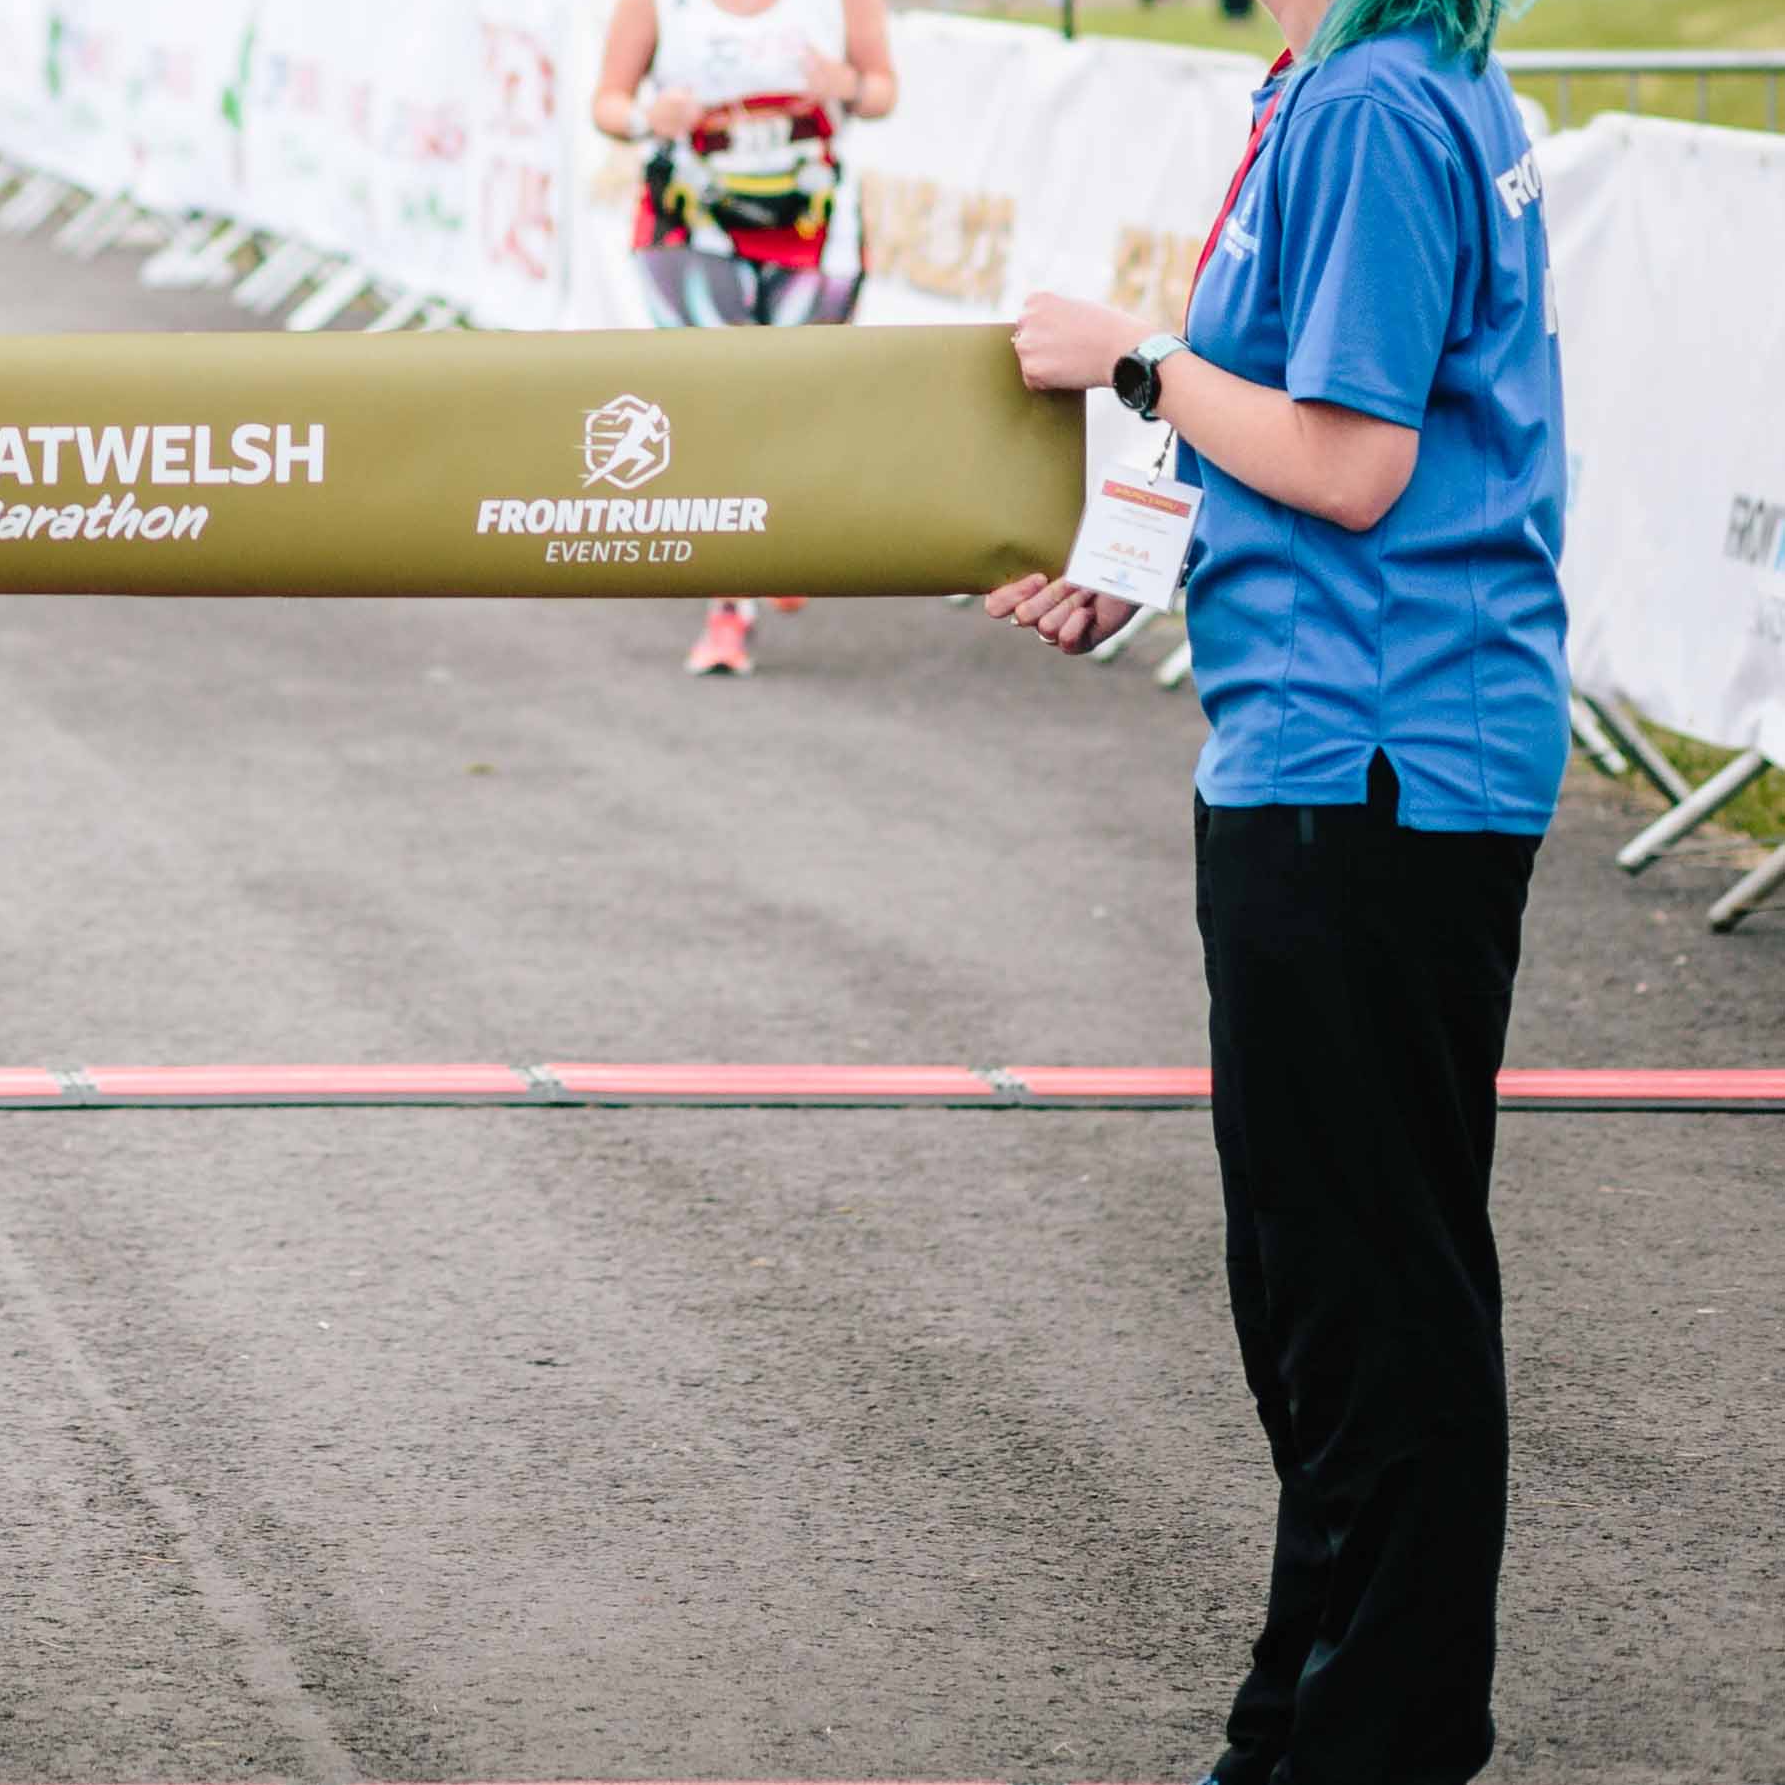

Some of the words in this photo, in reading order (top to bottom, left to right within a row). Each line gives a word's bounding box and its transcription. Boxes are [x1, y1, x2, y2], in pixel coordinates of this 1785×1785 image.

[477, 498, 768, 534] FRONTRUNNER
[545, 540, 640, 563] EVENTS
[647, 540, 692, 562] LTD
